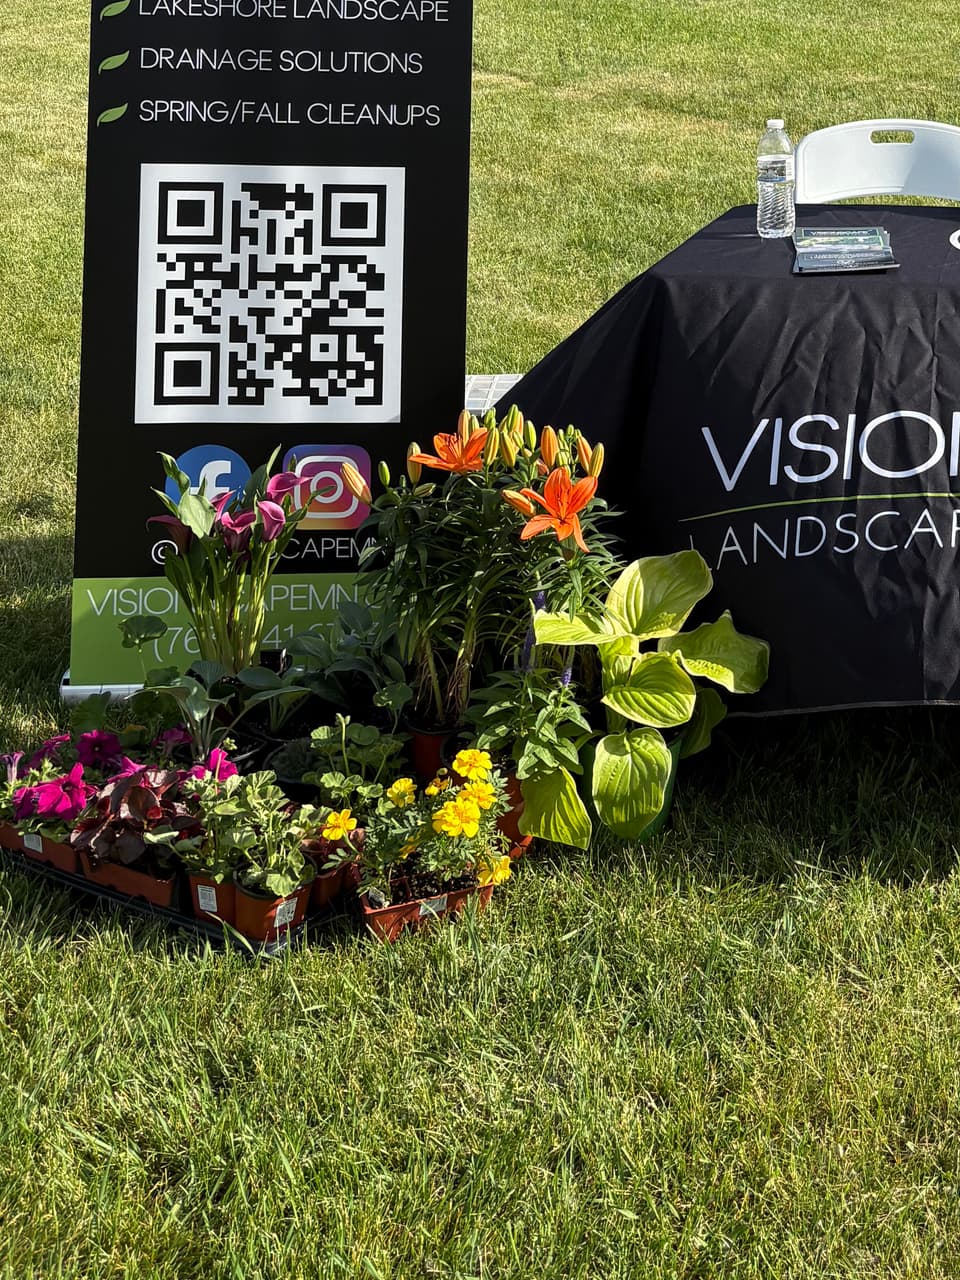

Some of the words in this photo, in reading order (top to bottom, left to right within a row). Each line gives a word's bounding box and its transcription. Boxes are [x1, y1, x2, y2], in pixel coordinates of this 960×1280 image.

[140, 47, 273, 72] DRAINAGE
[279, 50, 423, 74] SOLUTIONS
[138, 99, 301, 126] SPRING/FALL
[306, 102, 441, 127] CLEANUPS
